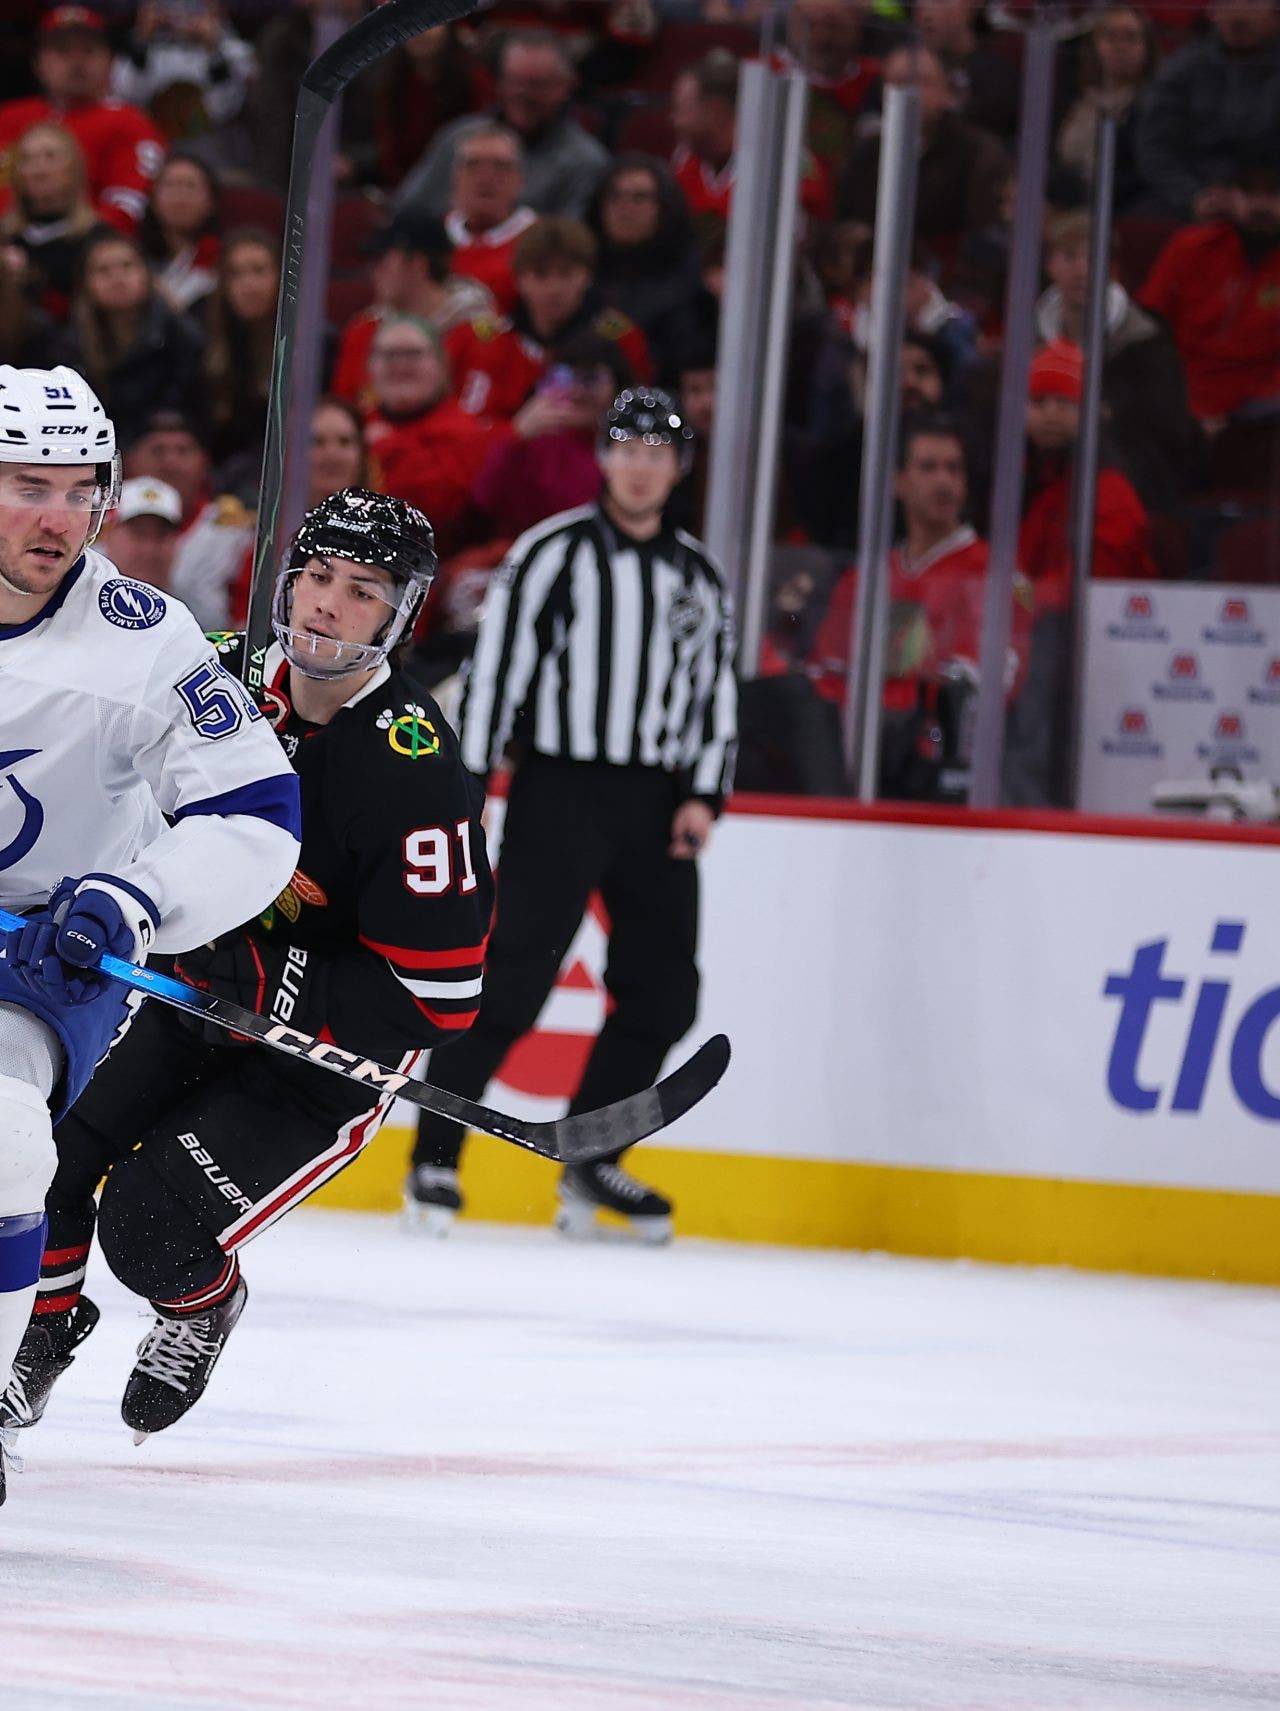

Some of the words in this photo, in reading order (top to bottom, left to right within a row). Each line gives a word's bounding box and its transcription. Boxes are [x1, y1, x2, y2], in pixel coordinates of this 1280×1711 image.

[43, 386, 73, 399] 51
[41, 425, 88, 435] CCM
[100, 589, 111, 608] BAY
[106, 579, 161, 600] LIGHTNING
[105, 609, 140, 628] TAMPA
[402, 817, 478, 897] 91
[66, 930, 97, 950] CCM
[263, 1024, 410, 1097] CCM
